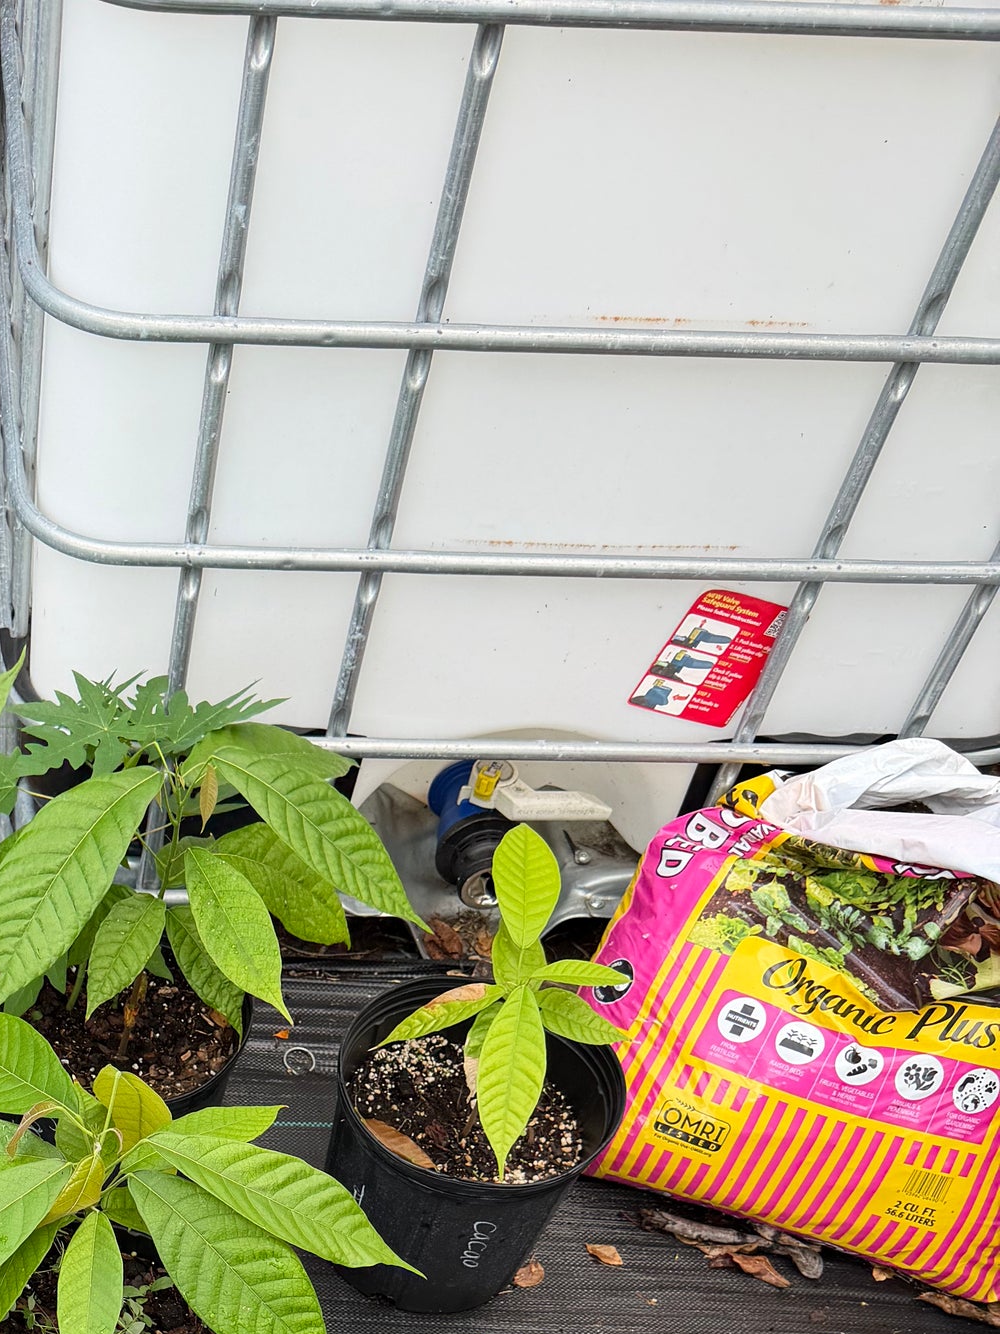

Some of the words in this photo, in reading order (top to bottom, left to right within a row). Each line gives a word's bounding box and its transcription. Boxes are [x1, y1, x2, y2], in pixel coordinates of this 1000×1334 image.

[706, 592, 723, 600] NEW
[722, 596, 740, 605] Valve
[696, 604, 713, 613] Please
[713, 608, 731, 618] follow
[702, 597, 737, 611] Safeguard
[735, 606, 759, 618] System
[762, 958, 897, 1036] Organic
[905, 1002, 1000, 1049] Plus
[727, 1012, 757, 1028] NUTRIENTS
[710, 1044, 740, 1060] FERTILIZER
[720, 1041, 738, 1051] FROM
[768, 1060, 790, 1072] RAISED
[788, 1066, 805, 1077] BEDS
[819, 1078, 841, 1091] FRUITS,
[840, 1084, 875, 1100] VEGETABLES
[836, 1091, 857, 1102] HERBS
[663, 1107, 726, 1143] OMRI
[945, 1112, 959, 1121] FOR
[958, 1114, 982, 1125] ORGANIC
[657, 1124, 717, 1151] LISTED
[662, 1136, 679, 1146] Organic
[885, 1207, 905, 1219] 56.6
[905, 1213, 936, 1227] LITERS
[894, 1200, 902, 1208] 2
[903, 1202, 919, 1214] CU.
[921, 1207, 936, 1218] FT.
[460, 1221, 497, 1269] Cacao
